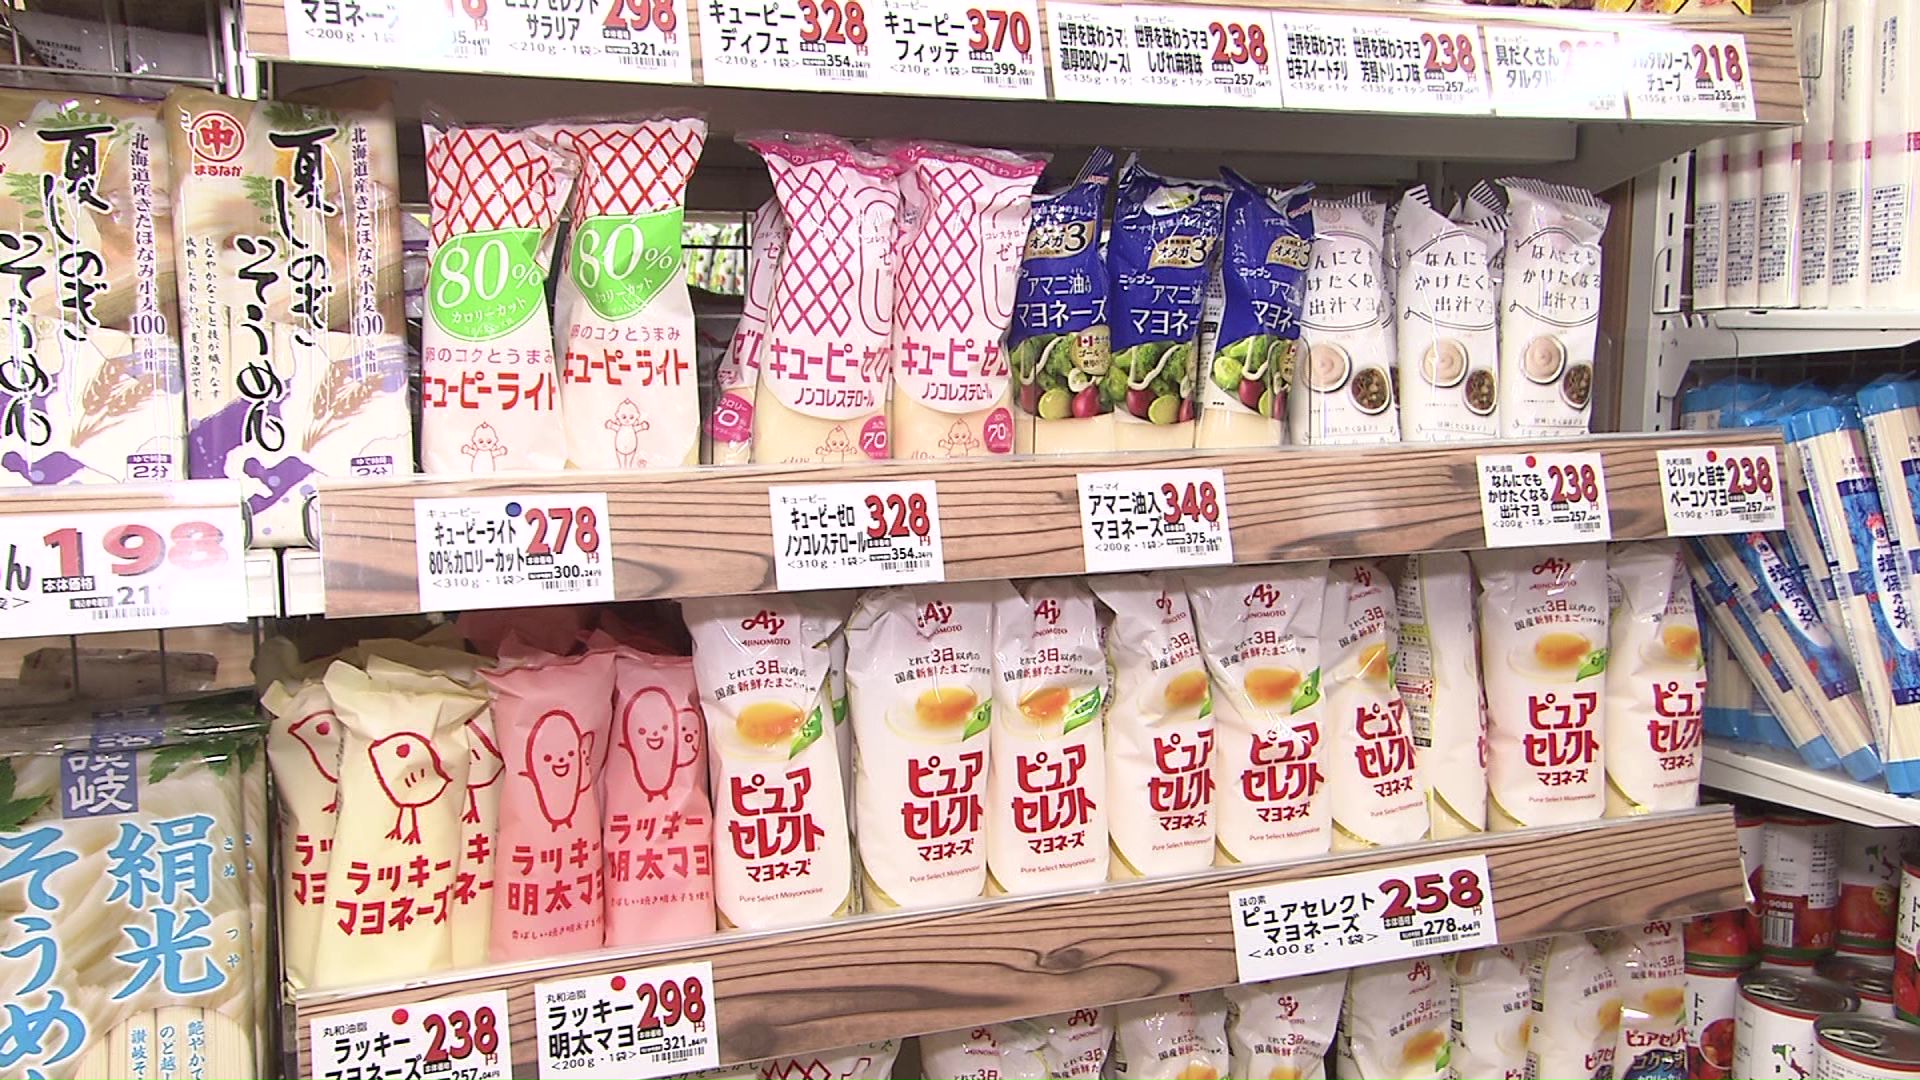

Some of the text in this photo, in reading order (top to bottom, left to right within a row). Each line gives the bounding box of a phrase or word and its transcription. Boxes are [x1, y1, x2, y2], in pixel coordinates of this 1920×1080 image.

[526, 14, 581, 41] サラリア
[603, 0, 677, 32] 298
[800, 0, 869, 44] 328
[967, 8, 1031, 54] 370
[721, 27, 789, 55] ディフェ
[896, 38, 959, 64] フィッテ
[1135, 25, 1208, 50] 世界を味わうマヨ
[1208, 22, 1269, 64] 238
[1421, 33, 1476, 73] 238
[1495, 44, 1560, 67] 具だくさん
[1691, 44, 1743, 82] 218
[1646, 73, 1682, 93] チューブ
[195, 164, 243, 177] まるなか
[580, 223, 672, 288] 80%
[437, 240, 541, 308] 80%
[1543, 291, 1591, 313] 出汁マヨ
[795, 388, 875, 408] ノンコレステロール
[922, 382, 993, 402] ノンコレステロール
[863, 431, 886, 450] 70
[987, 421, 1006, 442] 70
[132, 464, 171, 479] 2分
[1491, 474, 1542, 488] なんにでも
[1548, 464, 1598, 503] 238
[1667, 465, 1726, 487] ピリッと旨辛
[1725, 456, 1772, 494] 238
[1089, 491, 1161, 516] アマニ油入
[1161, 481, 1219, 523] 348
[1488, 489, 1549, 503] かけたくなる
[1500, 504, 1540, 519] 出汁マヨ
[1670, 489, 1728, 507] ベーコンマヨ
[525, 507, 600, 554] 278
[865, 493, 930, 539] 328
[1092, 516, 1163, 541] マヨネーズ
[43, 520, 228, 577] 198
[785, 531, 868, 557] ノンコレステロール
[429, 548, 525, 575] 80%カロリーカット
[43, 577, 95, 592] 本体価格
[908, 647, 981, 667] とれて3日以内の
[1356, 699, 1404, 741] ピュア
[1528, 693, 1597, 731] ピュア
[1153, 728, 1214, 775] ピュア
[1250, 721, 1320, 766] ピュア
[1355, 736, 1416, 779] セレクト
[1523, 730, 1600, 768] セレクト
[908, 750, 983, 798] ピュア
[1016, 743, 1087, 794] ピュア
[1240, 762, 1325, 802] セレクト
[1537, 768, 1589, 787] マヨネーズ
[730, 768, 812, 816] ピュア
[1148, 768, 1215, 812] セレクト
[1374, 775, 1414, 798] マヨネーズ
[901, 794, 984, 840] セレクト
[1011, 787, 1097, 833] セレクト
[1159, 810, 1208, 831] マヨネーズ
[1256, 801, 1311, 823] マヨネーズ
[610, 811, 704, 845] ラッキー
[728, 813, 825, 860] セレクト
[1028, 830, 1085, 855] マヨネーズ
[608, 844, 711, 883] 明太マヨ
[917, 838, 974, 862] マヨネーズ
[347, 855, 451, 896] ラッキー
[746, 858, 811, 883] マヨネーズ
[107, 815, 225, 1000] 絹光
[1239, 895, 1266, 907] 味の素
[1243, 892, 1376, 928] ピュアセレクト
[1378, 869, 1484, 919] 258
[1263, 913, 1360, 944] マヨネーズ
[225, 927, 240, 968] つや
[548, 999, 634, 1031] ラッキー
[636, 976, 706, 1030] 298
[334, 1031, 410, 1064] ラッキー
[423, 1006, 499, 1062] 238
[549, 1024, 635, 1060] 明太マヨ
